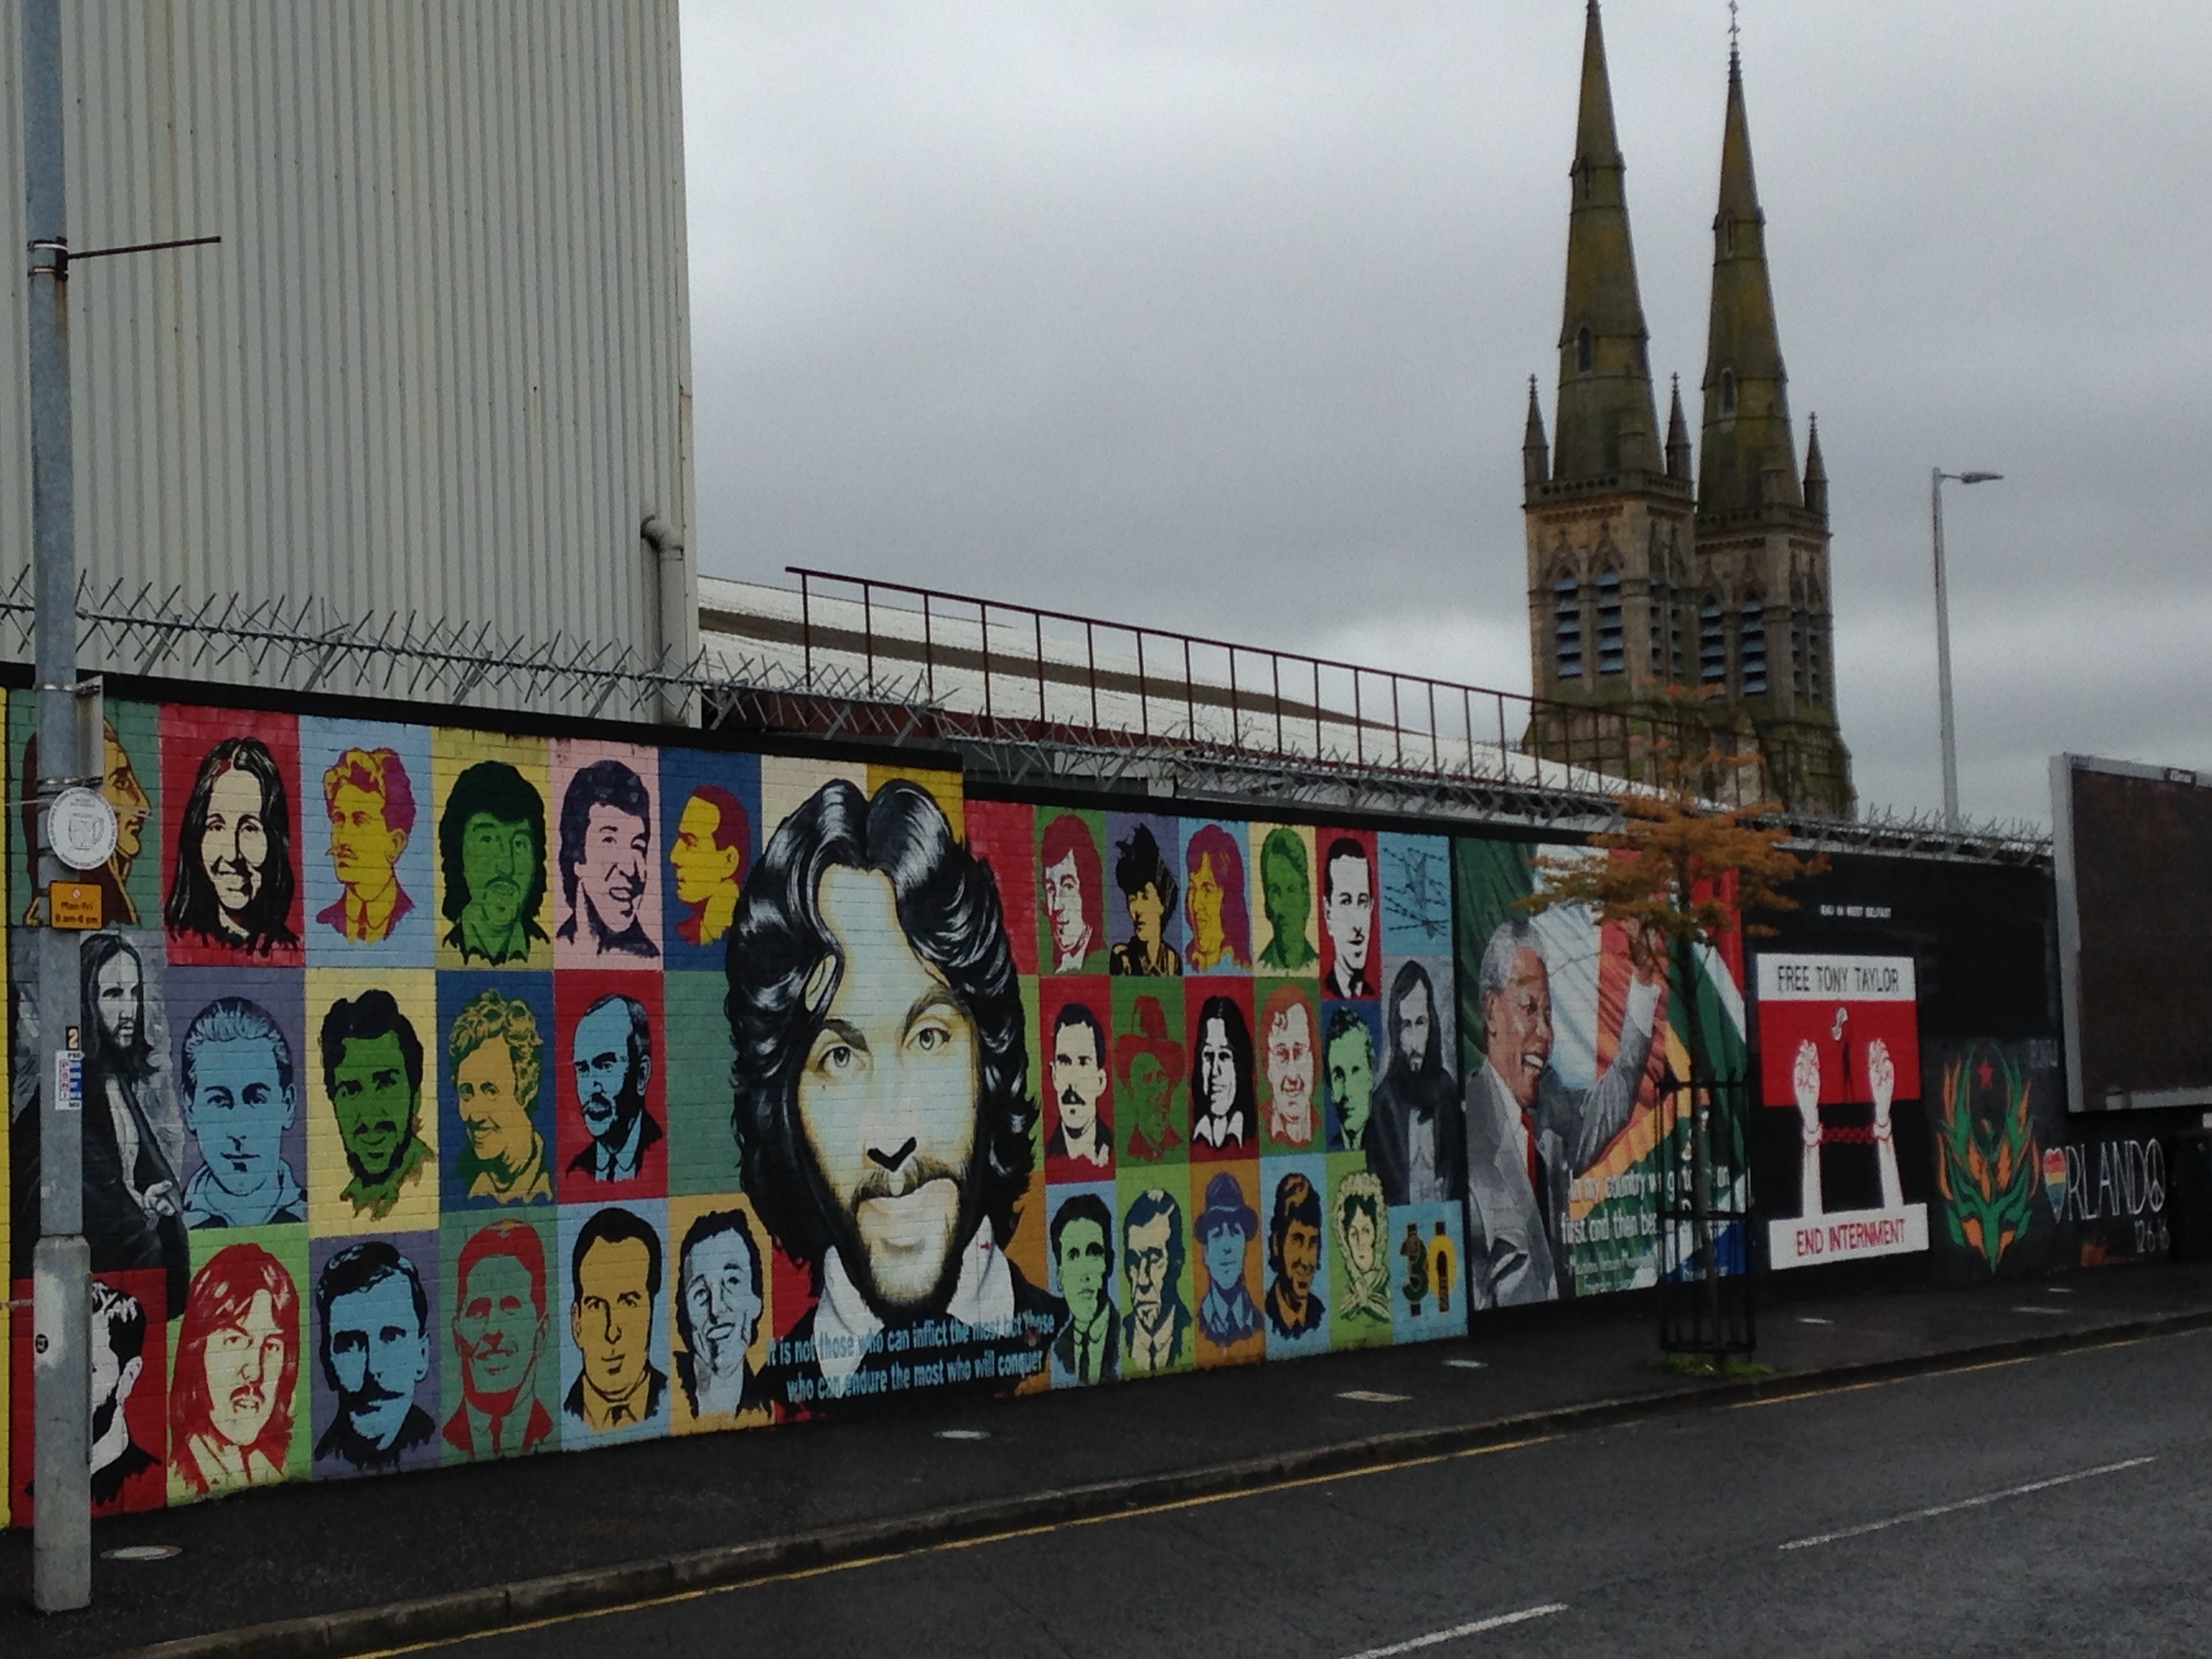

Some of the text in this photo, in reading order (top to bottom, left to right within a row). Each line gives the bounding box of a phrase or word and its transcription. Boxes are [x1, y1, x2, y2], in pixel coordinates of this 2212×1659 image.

[1778, 964, 1899, 993] FREE TONY TAYLOR
[1796, 1218, 1906, 1257] END INTERNMENT
[779, 1335, 792, 1366] is
[795, 1333, 817, 1364] not
[819, 1331, 855, 1361] those
[857, 1327, 884, 1355] who
[887, 1328, 909, 1353] can
[912, 1319, 949, 1349] inflict
[949, 1317, 970, 1346] the
[972, 1315, 1001, 1342] most
[1004, 1312, 1023, 1339] but
[786, 1349, 1044, 1403] who can endure the most who will conquer
